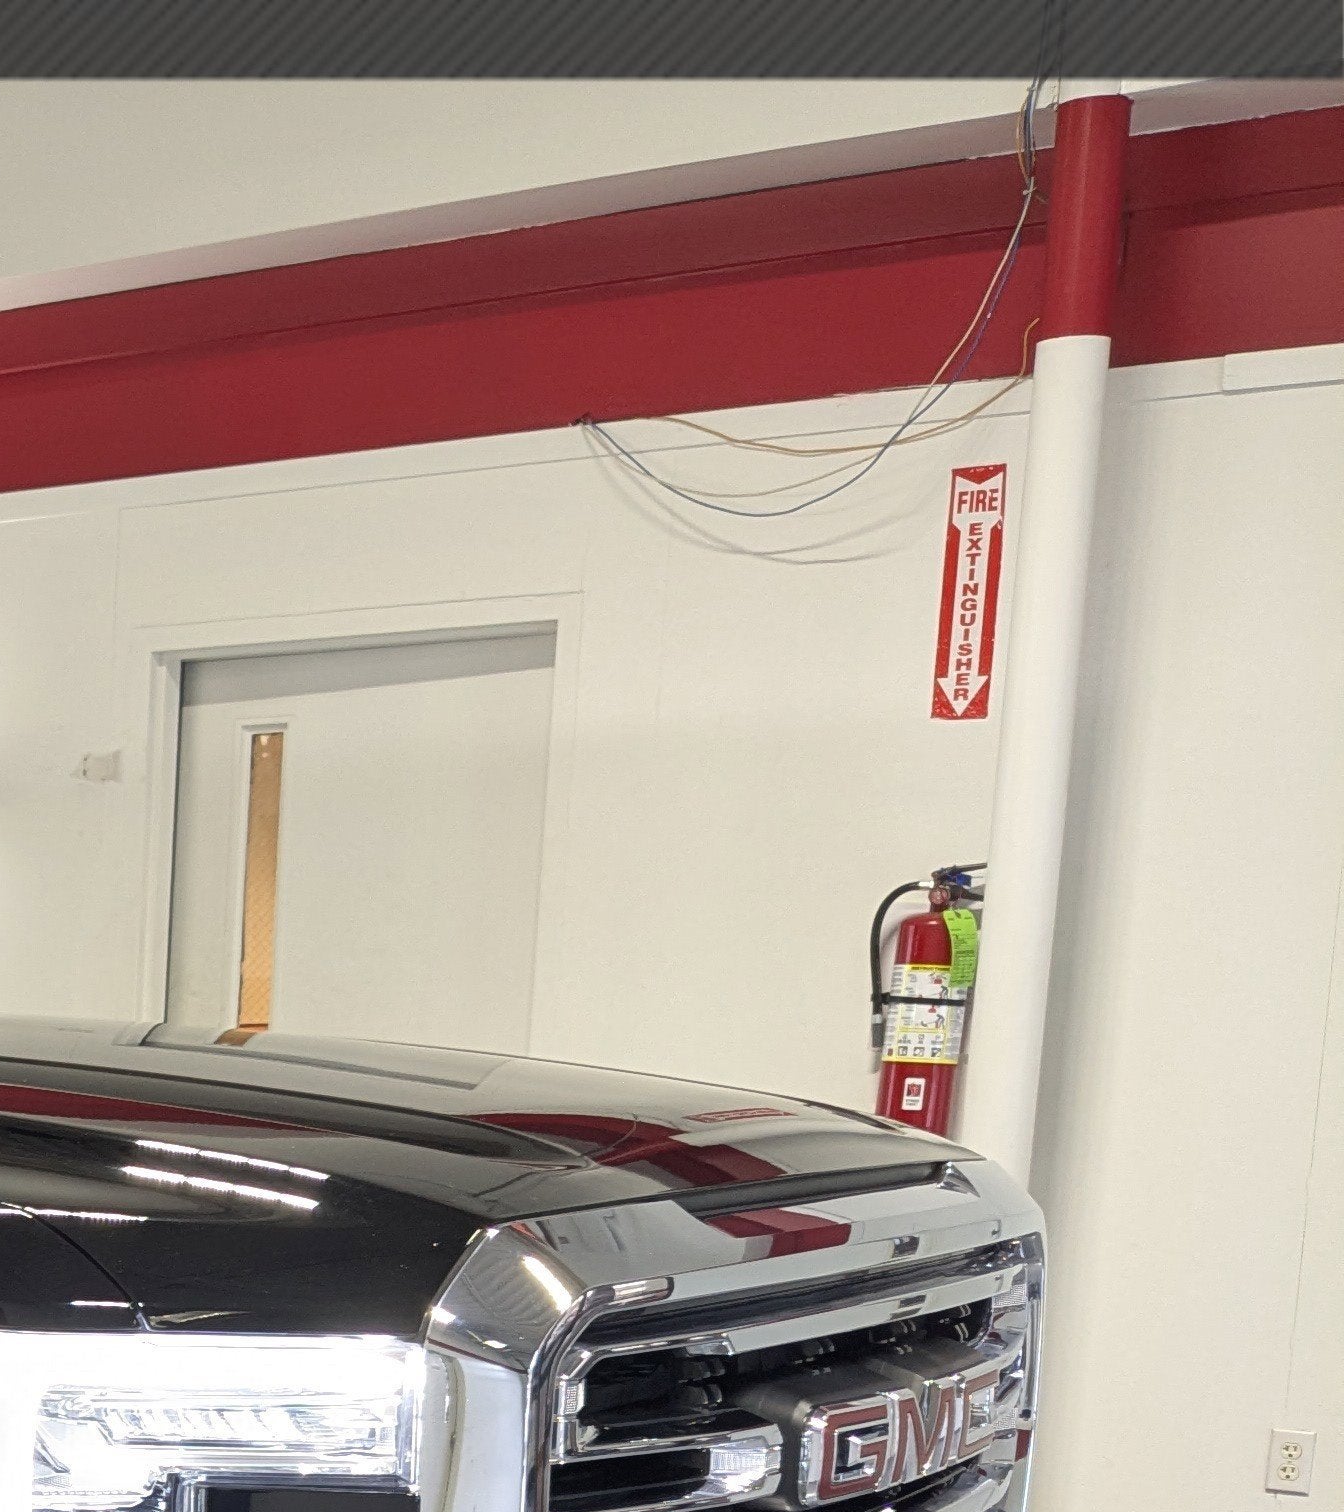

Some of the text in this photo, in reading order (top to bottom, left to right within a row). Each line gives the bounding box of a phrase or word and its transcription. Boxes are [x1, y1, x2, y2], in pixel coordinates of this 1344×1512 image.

[956, 487, 1000, 515] FIRE
[952, 521, 985, 702] EXTINGUISHER
[804, 1366, 1000, 1504] GMC
